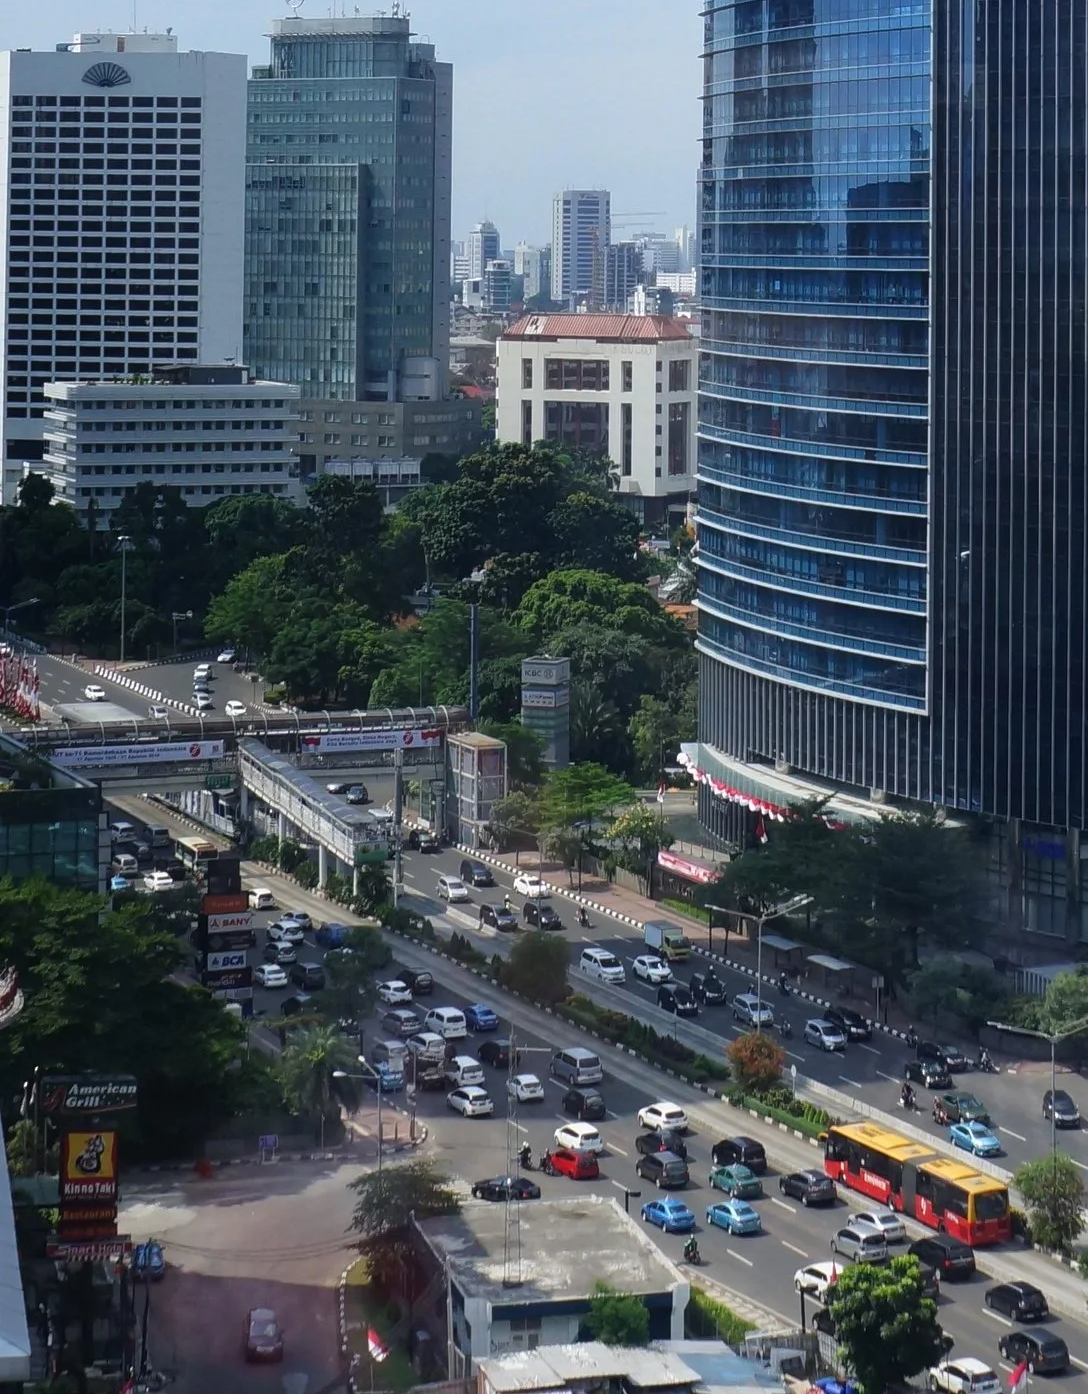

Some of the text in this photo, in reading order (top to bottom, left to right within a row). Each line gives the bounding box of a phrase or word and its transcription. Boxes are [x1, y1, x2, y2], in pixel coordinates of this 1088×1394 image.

[524, 669, 543, 677] ICBC
[222, 917, 250, 927] SANY
[221, 955, 244, 967] BCA
[68, 1082, 138, 1095] American
[66, 1095, 100, 1108] Grill
